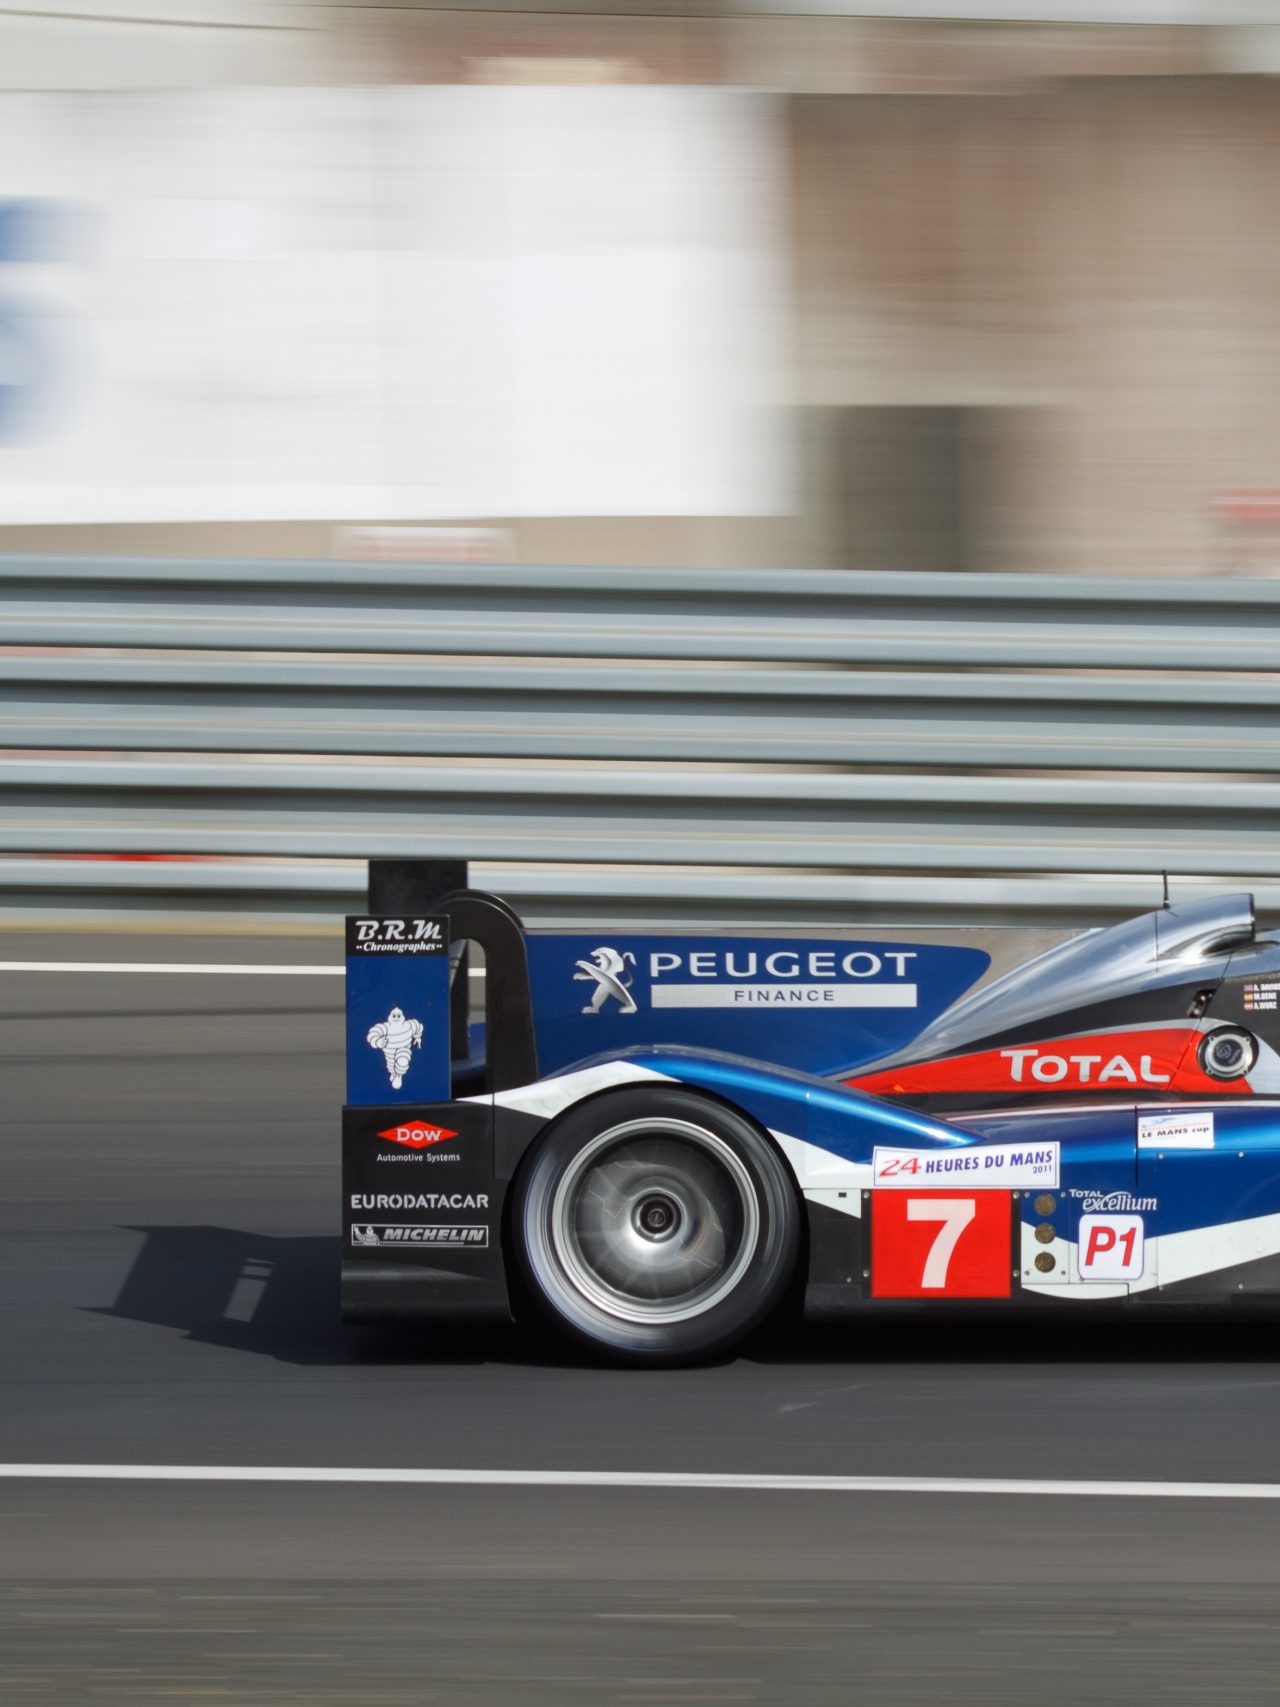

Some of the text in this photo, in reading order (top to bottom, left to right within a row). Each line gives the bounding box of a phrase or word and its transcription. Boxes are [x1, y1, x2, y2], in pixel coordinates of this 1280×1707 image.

[363, 941, 435, 953] Chronographes
[650, 951, 918, 978] PEUGEOT
[734, 990, 835, 1002] FINANCE
[1000, 1048, 1170, 1083] TOTAL
[1157, 1128, 1188, 1136] MANS
[377, 1153, 460, 1163] Automotive Systems
[879, 1150, 1053, 1177] 24 HEURES DU MANS
[1033, 1165, 1052, 1175] 2011
[1069, 1188, 1104, 1198] TOTAL
[351, 1193, 489, 1209] EURODATACAR
[1082, 1191, 1157, 1213] excellium
[383, 1227, 485, 1241] MICHELIN
[906, 1198, 976, 1289] 7
[1085, 1225, 1137, 1267] P1
